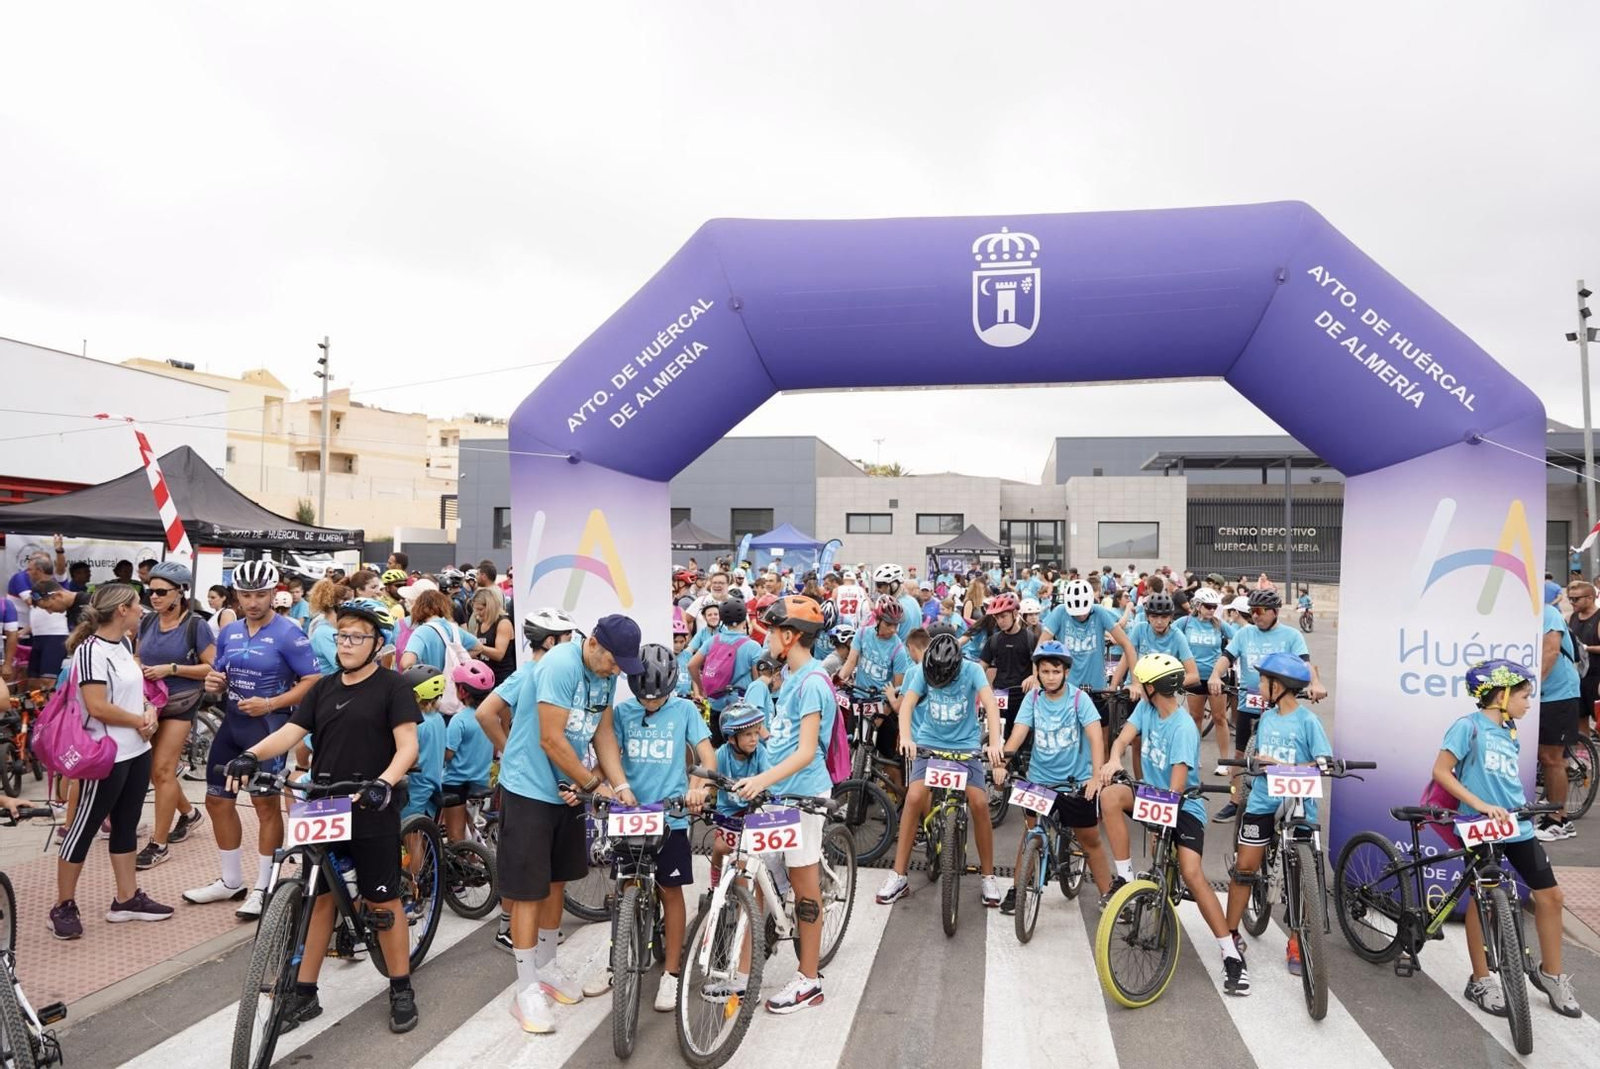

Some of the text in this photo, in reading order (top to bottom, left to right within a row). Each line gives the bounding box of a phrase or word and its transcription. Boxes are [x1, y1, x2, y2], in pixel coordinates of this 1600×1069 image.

[1306, 265, 1476, 412] AYTO. DE HUÉRCAL
[567, 298, 714, 433] AYTO. DE HUÉRCAL
[1314, 310, 1426, 409] DE ALMERÍA
[609, 341, 709, 429] DE ALMERÍA
[304, 531, 314, 541] DE
[1218, 527, 1317, 537] CENTRO DEPOTIVO
[1214, 542, 1259, 552] HUERCAL
[1261, 543, 1275, 552] DE
[840, 600, 858, 614] 23
[1399, 628, 1539, 668] Huércal
[929, 701, 968, 721] BICI
[645, 730, 659, 738] DE
[660, 730, 673, 738] LA
[628, 738, 674, 759] BICI
[929, 770, 961, 789] 361
[1273, 778, 1316, 795] 507
[1013, 791, 1047, 813] 438
[1137, 801, 1173, 824] 505
[294, 817, 345, 843] 025
[614, 814, 659, 834] 195
[1467, 820, 1514, 841] 440
[752, 828, 798, 852] 362
[1423, 865, 1447, 880] DE
